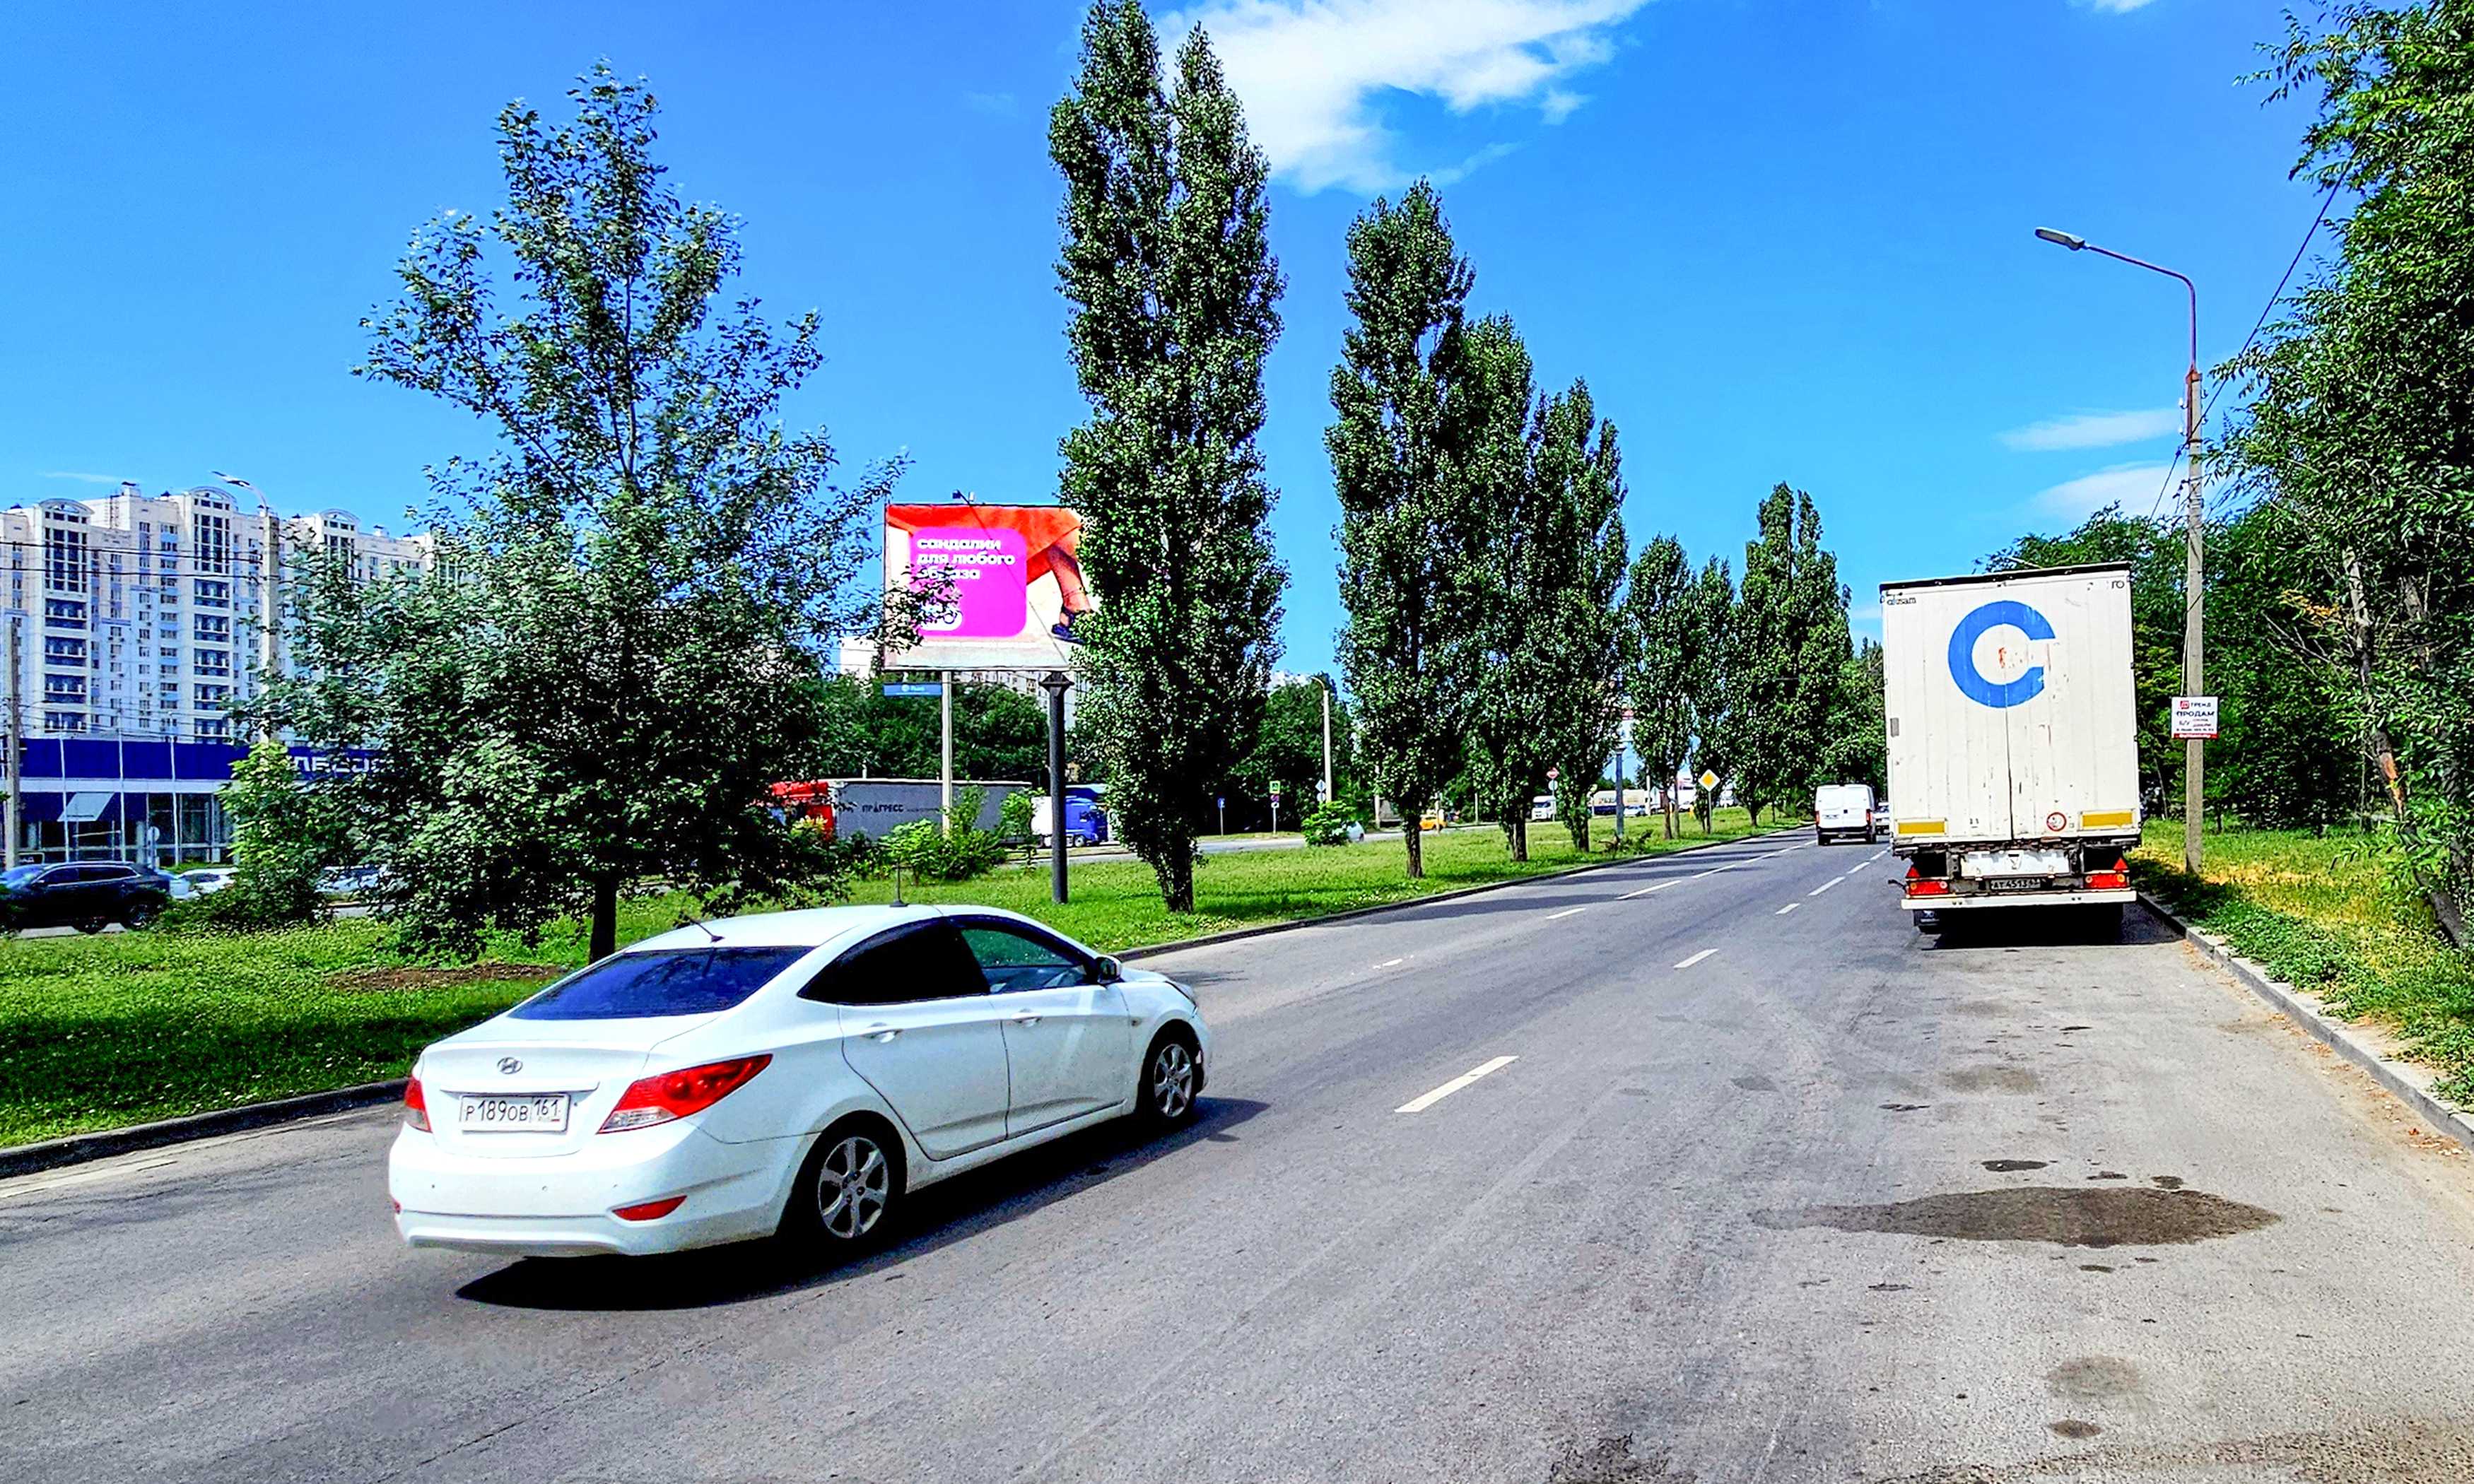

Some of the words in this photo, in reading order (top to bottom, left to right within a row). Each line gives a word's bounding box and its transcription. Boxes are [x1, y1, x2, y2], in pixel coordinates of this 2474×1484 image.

[917, 554, 949, 565] для
[951, 550, 1016, 565] любого
[534, 1099, 558, 1116] 161
